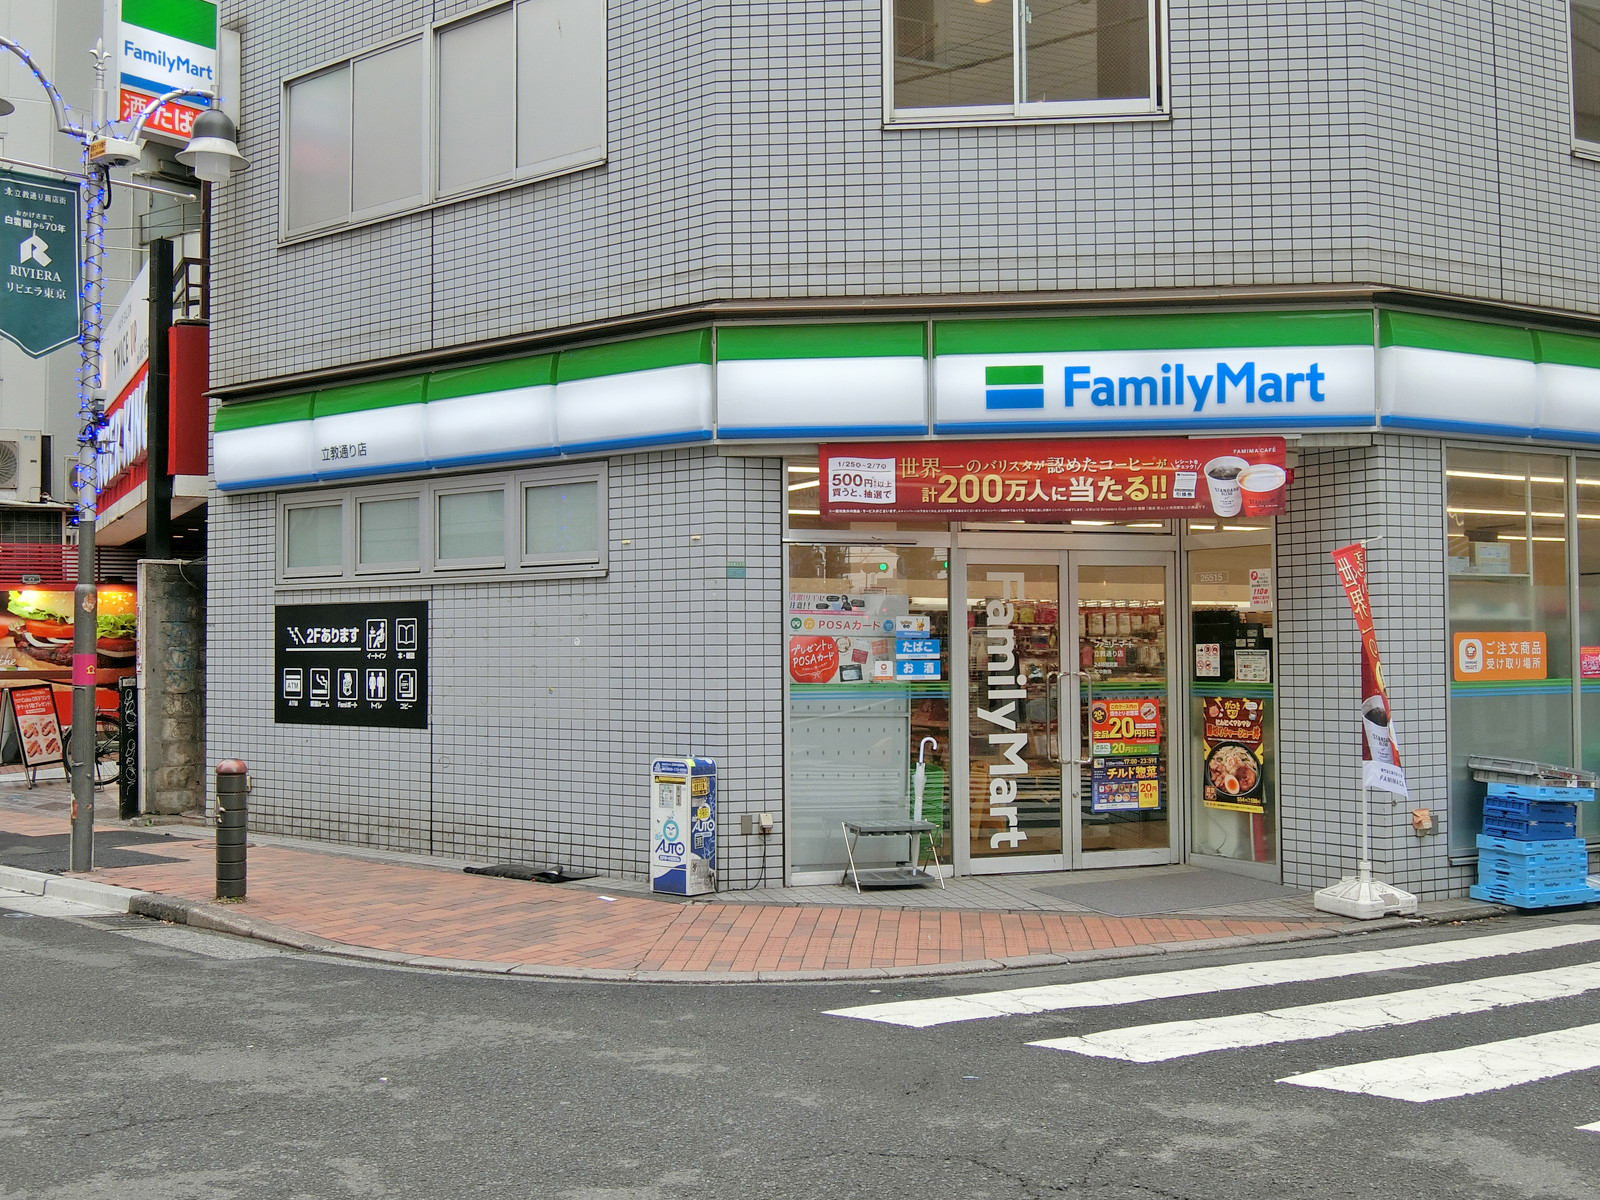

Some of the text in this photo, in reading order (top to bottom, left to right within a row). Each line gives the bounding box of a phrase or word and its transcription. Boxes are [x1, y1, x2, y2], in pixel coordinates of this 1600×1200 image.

[124, 40, 212, 80] FamilyMart
[10, 264, 62, 283] RIVIERA
[7, 281, 67, 300] リビエラ東京
[1064, 361, 1326, 413] FamilyMart
[321, 442, 367, 461] 立教通り店
[898, 456, 1168, 480] 世界一のバリスタが認めたコーヒーが
[832, 487, 892, 499] 買うと、抽選で
[921, 473, 1168, 504] 計200万人に当たる!!
[1200, 573, 1223, 582] 26515
[818, 619, 880, 631] POSAカード
[306, 626, 360, 644] 2Fあります
[1094, 640, 1135, 648] ファミリーマート
[791, 639, 833, 656] プレゼントに
[902, 641, 934, 653] たばこ
[1485, 640, 1541, 656] ご注文商品
[793, 651, 835, 669] POSAカード
[1486, 657, 1541, 670] 受け取り場所
[976, 571, 1029, 849] FamilyMart
[1093, 716, 1156, 739] 全品20円引き
[1106, 765, 1158, 780] チルド惣菜
[691, 819, 716, 833] AUTO
[655, 838, 685, 856] AUTO
